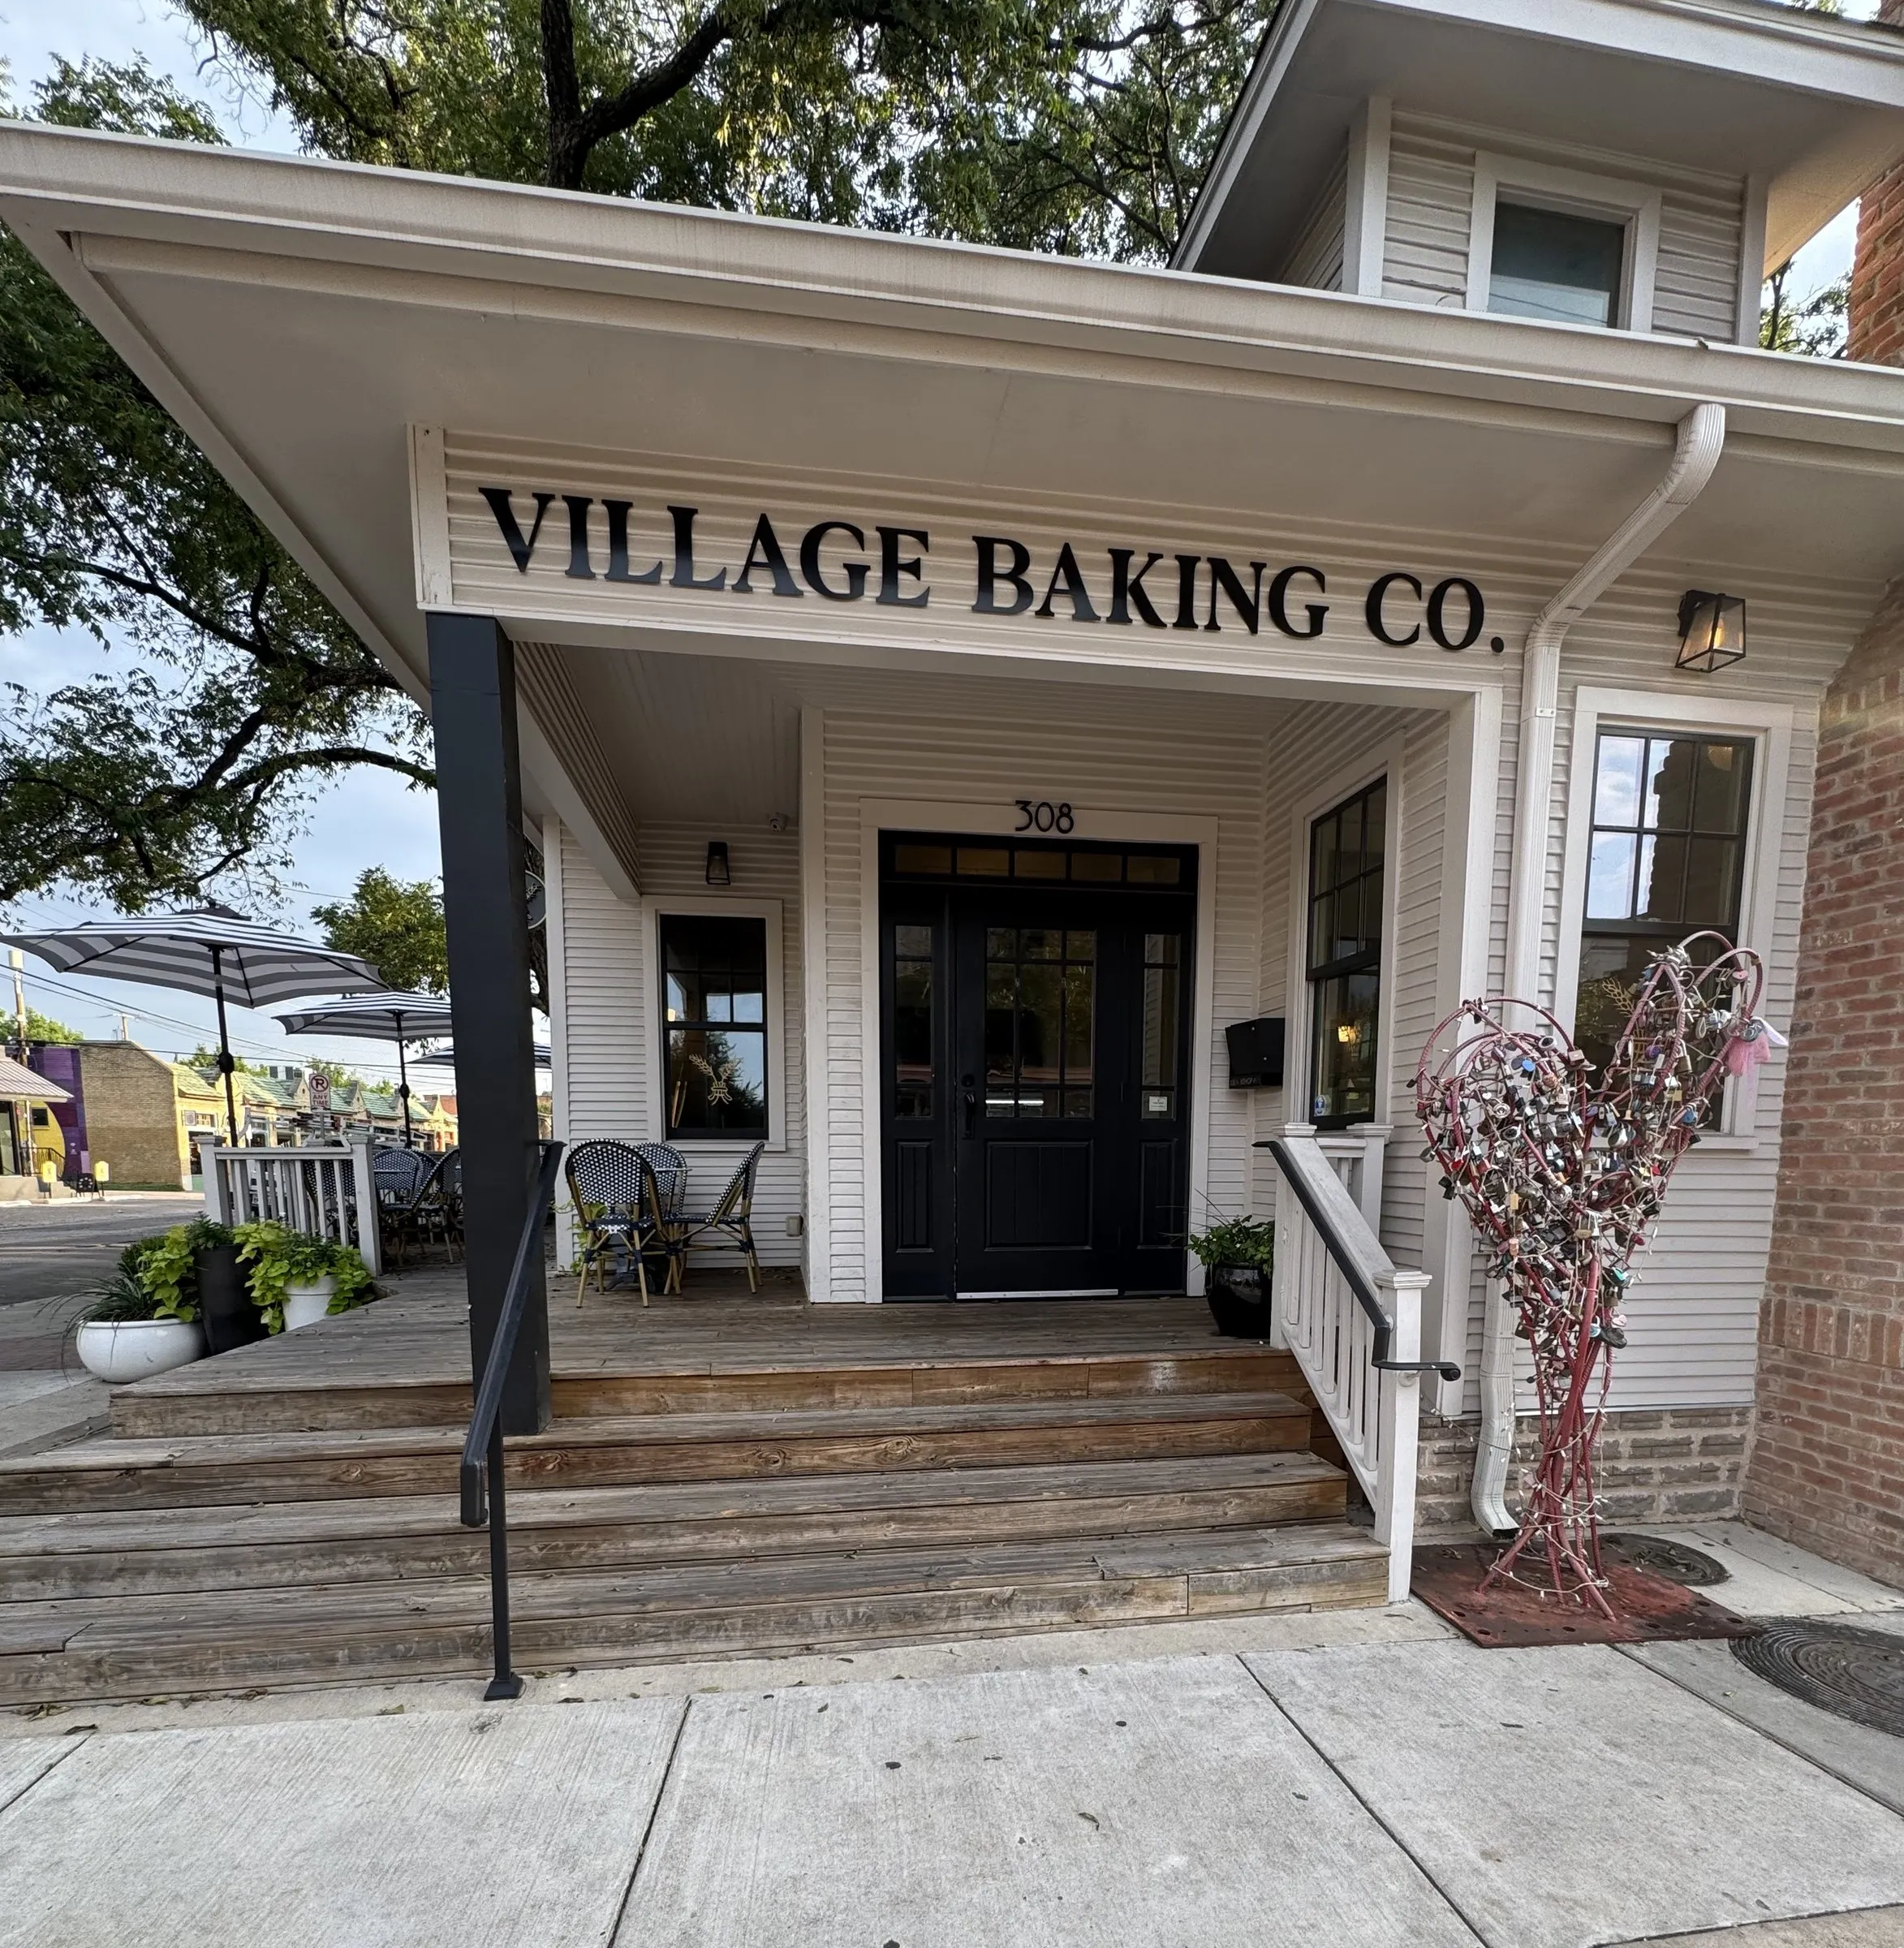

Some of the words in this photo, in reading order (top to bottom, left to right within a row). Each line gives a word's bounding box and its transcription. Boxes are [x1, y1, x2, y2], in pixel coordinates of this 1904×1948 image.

[478, 487, 930, 608] VILLAGE
[972, 536, 1330, 640] BAKING
[1365, 572, 1505, 653] CO.
[1014, 799, 1075, 834] 308
